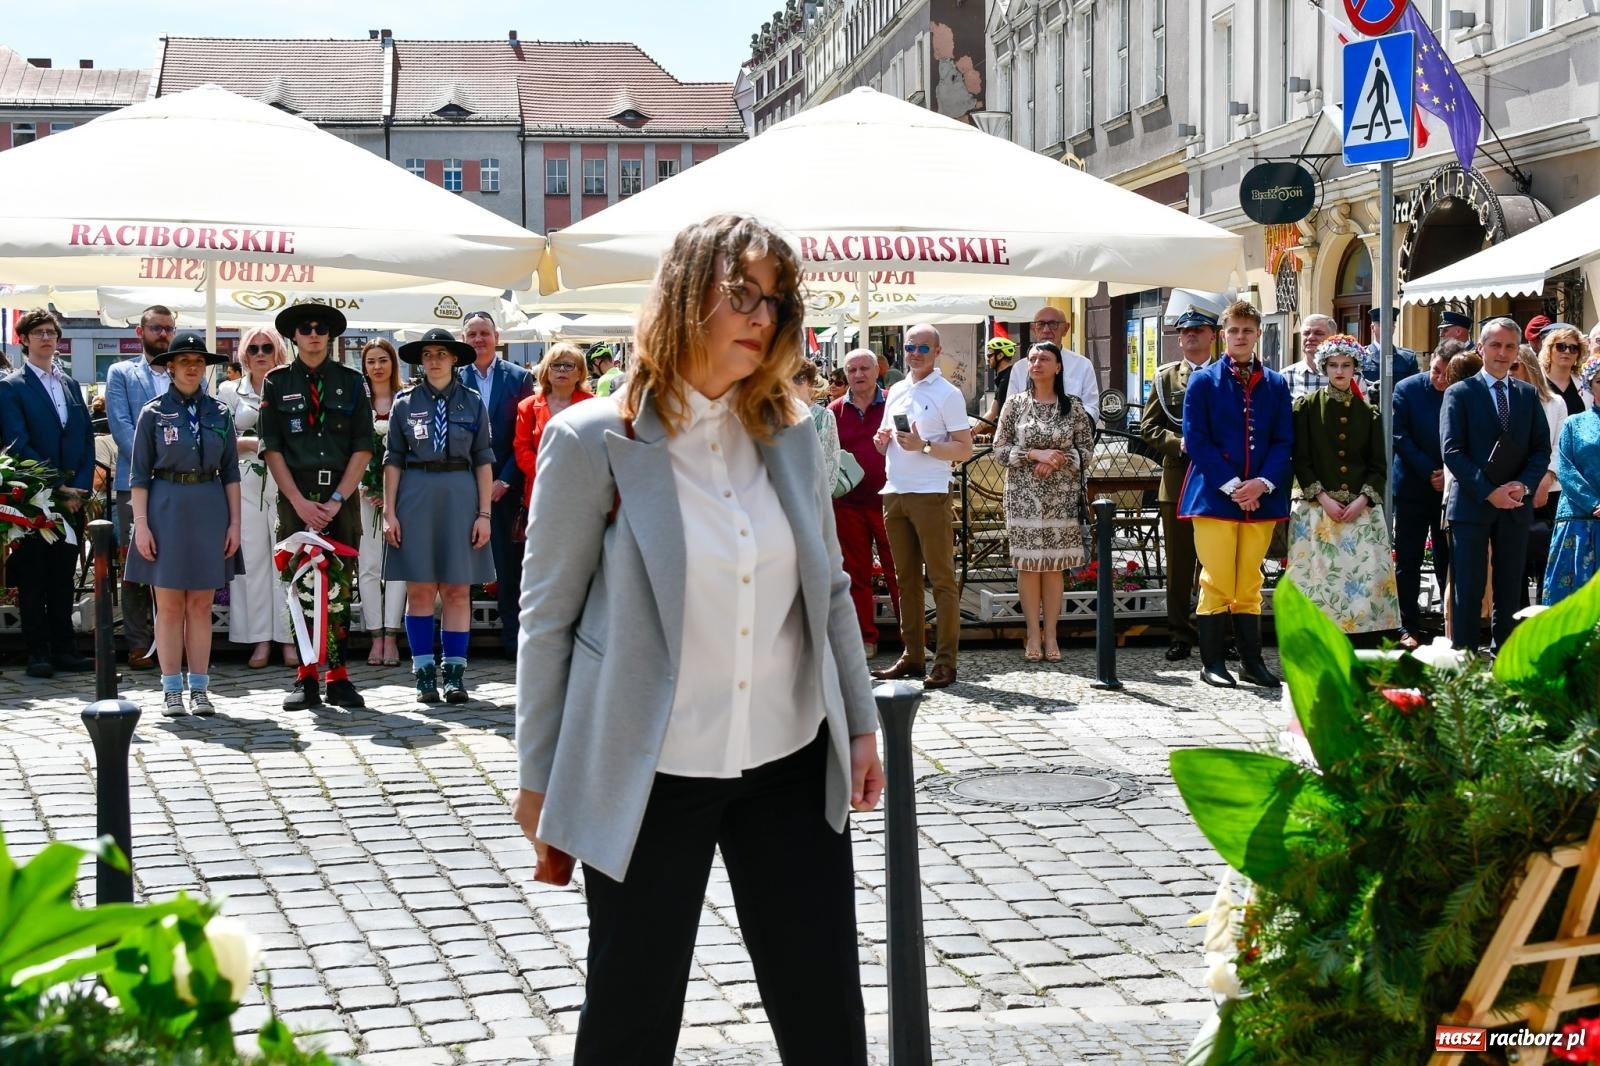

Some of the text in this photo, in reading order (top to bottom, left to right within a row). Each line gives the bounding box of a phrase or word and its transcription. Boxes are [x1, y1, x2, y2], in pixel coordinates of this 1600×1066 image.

[68, 223, 296, 254] RACIBORSKIE
[800, 236, 1010, 265] RACIBORSKIE
[850, 293, 917, 303] AGIDA
